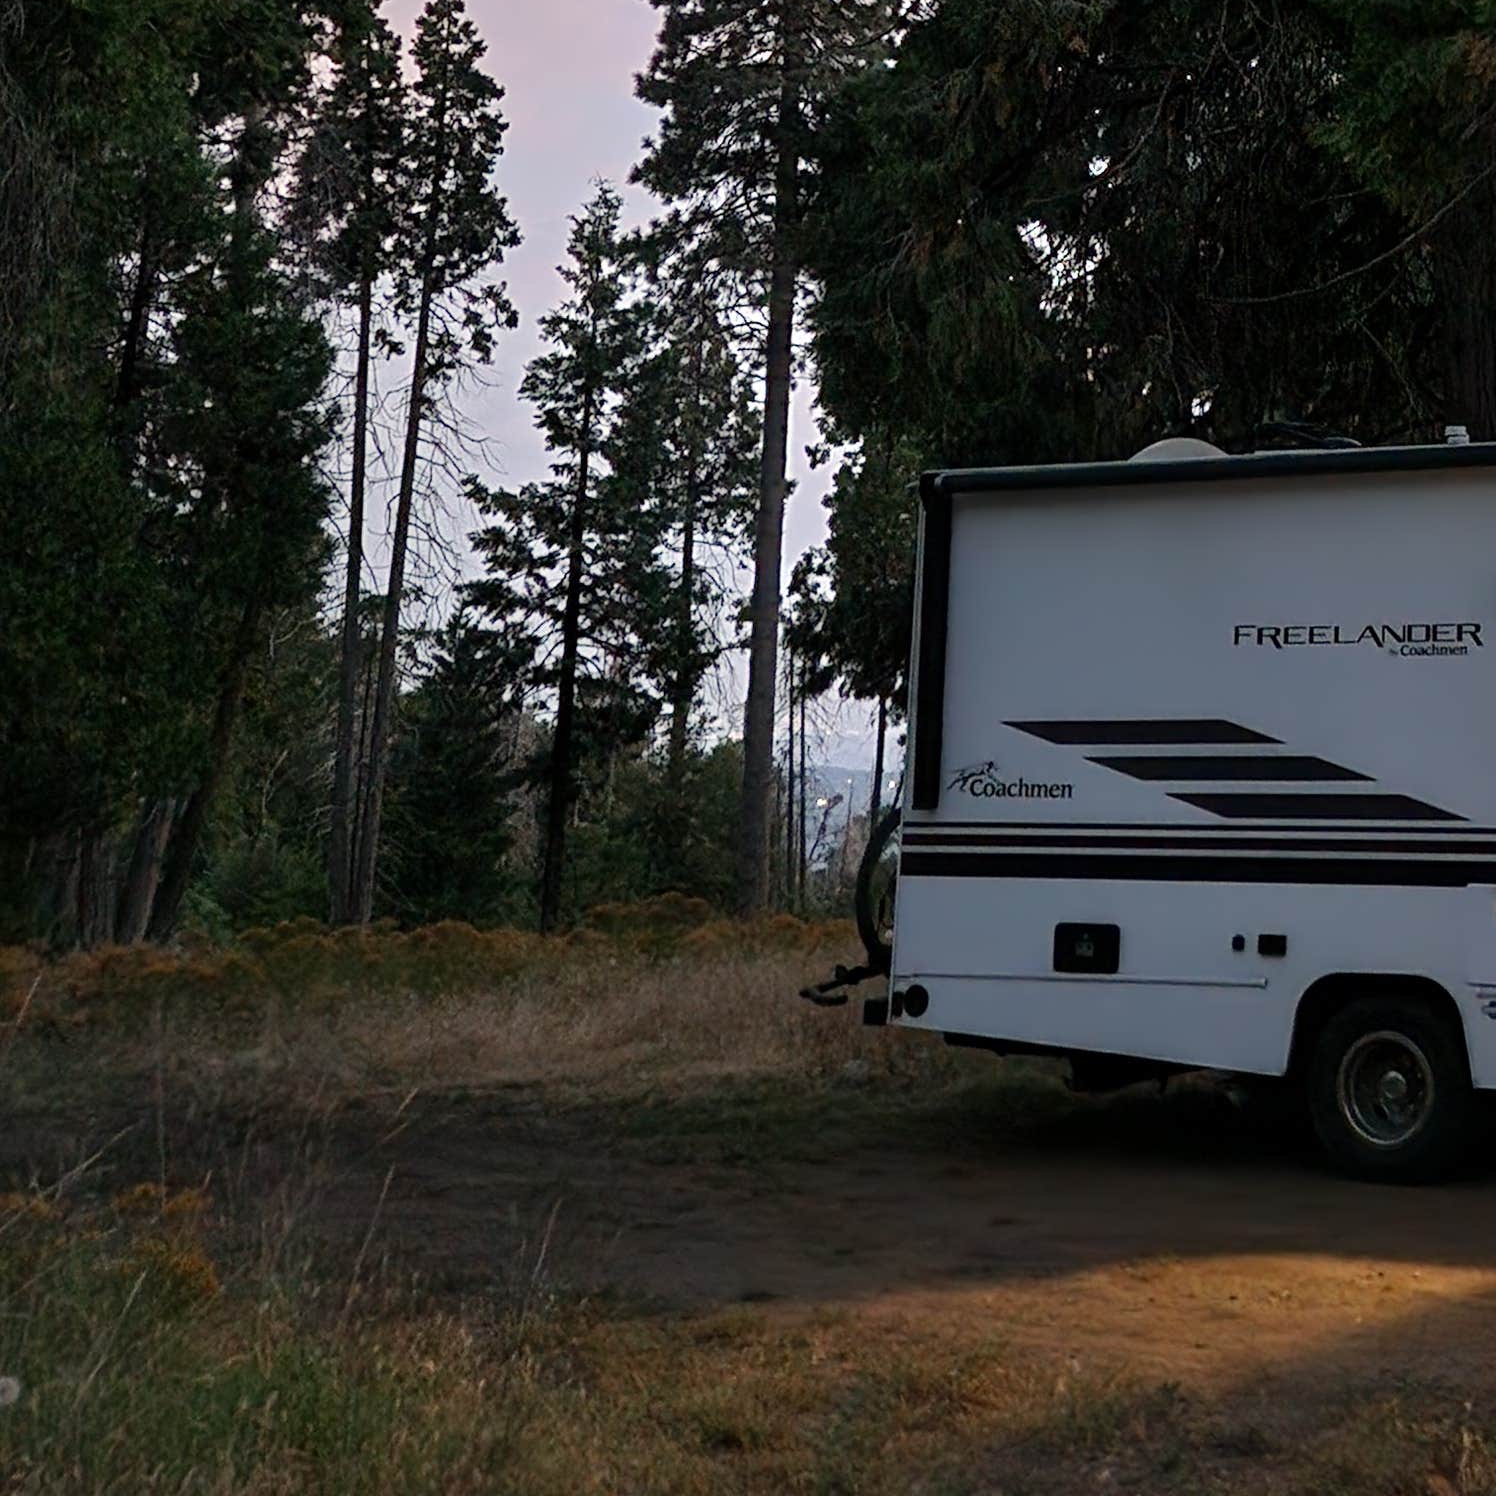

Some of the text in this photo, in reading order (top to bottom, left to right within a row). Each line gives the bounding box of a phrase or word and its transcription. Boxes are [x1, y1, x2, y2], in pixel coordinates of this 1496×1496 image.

[1234, 623, 1483, 648] FREELANDER
[1400, 644, 1468, 657] Coachmen
[970, 777, 1073, 798] Coachmen
